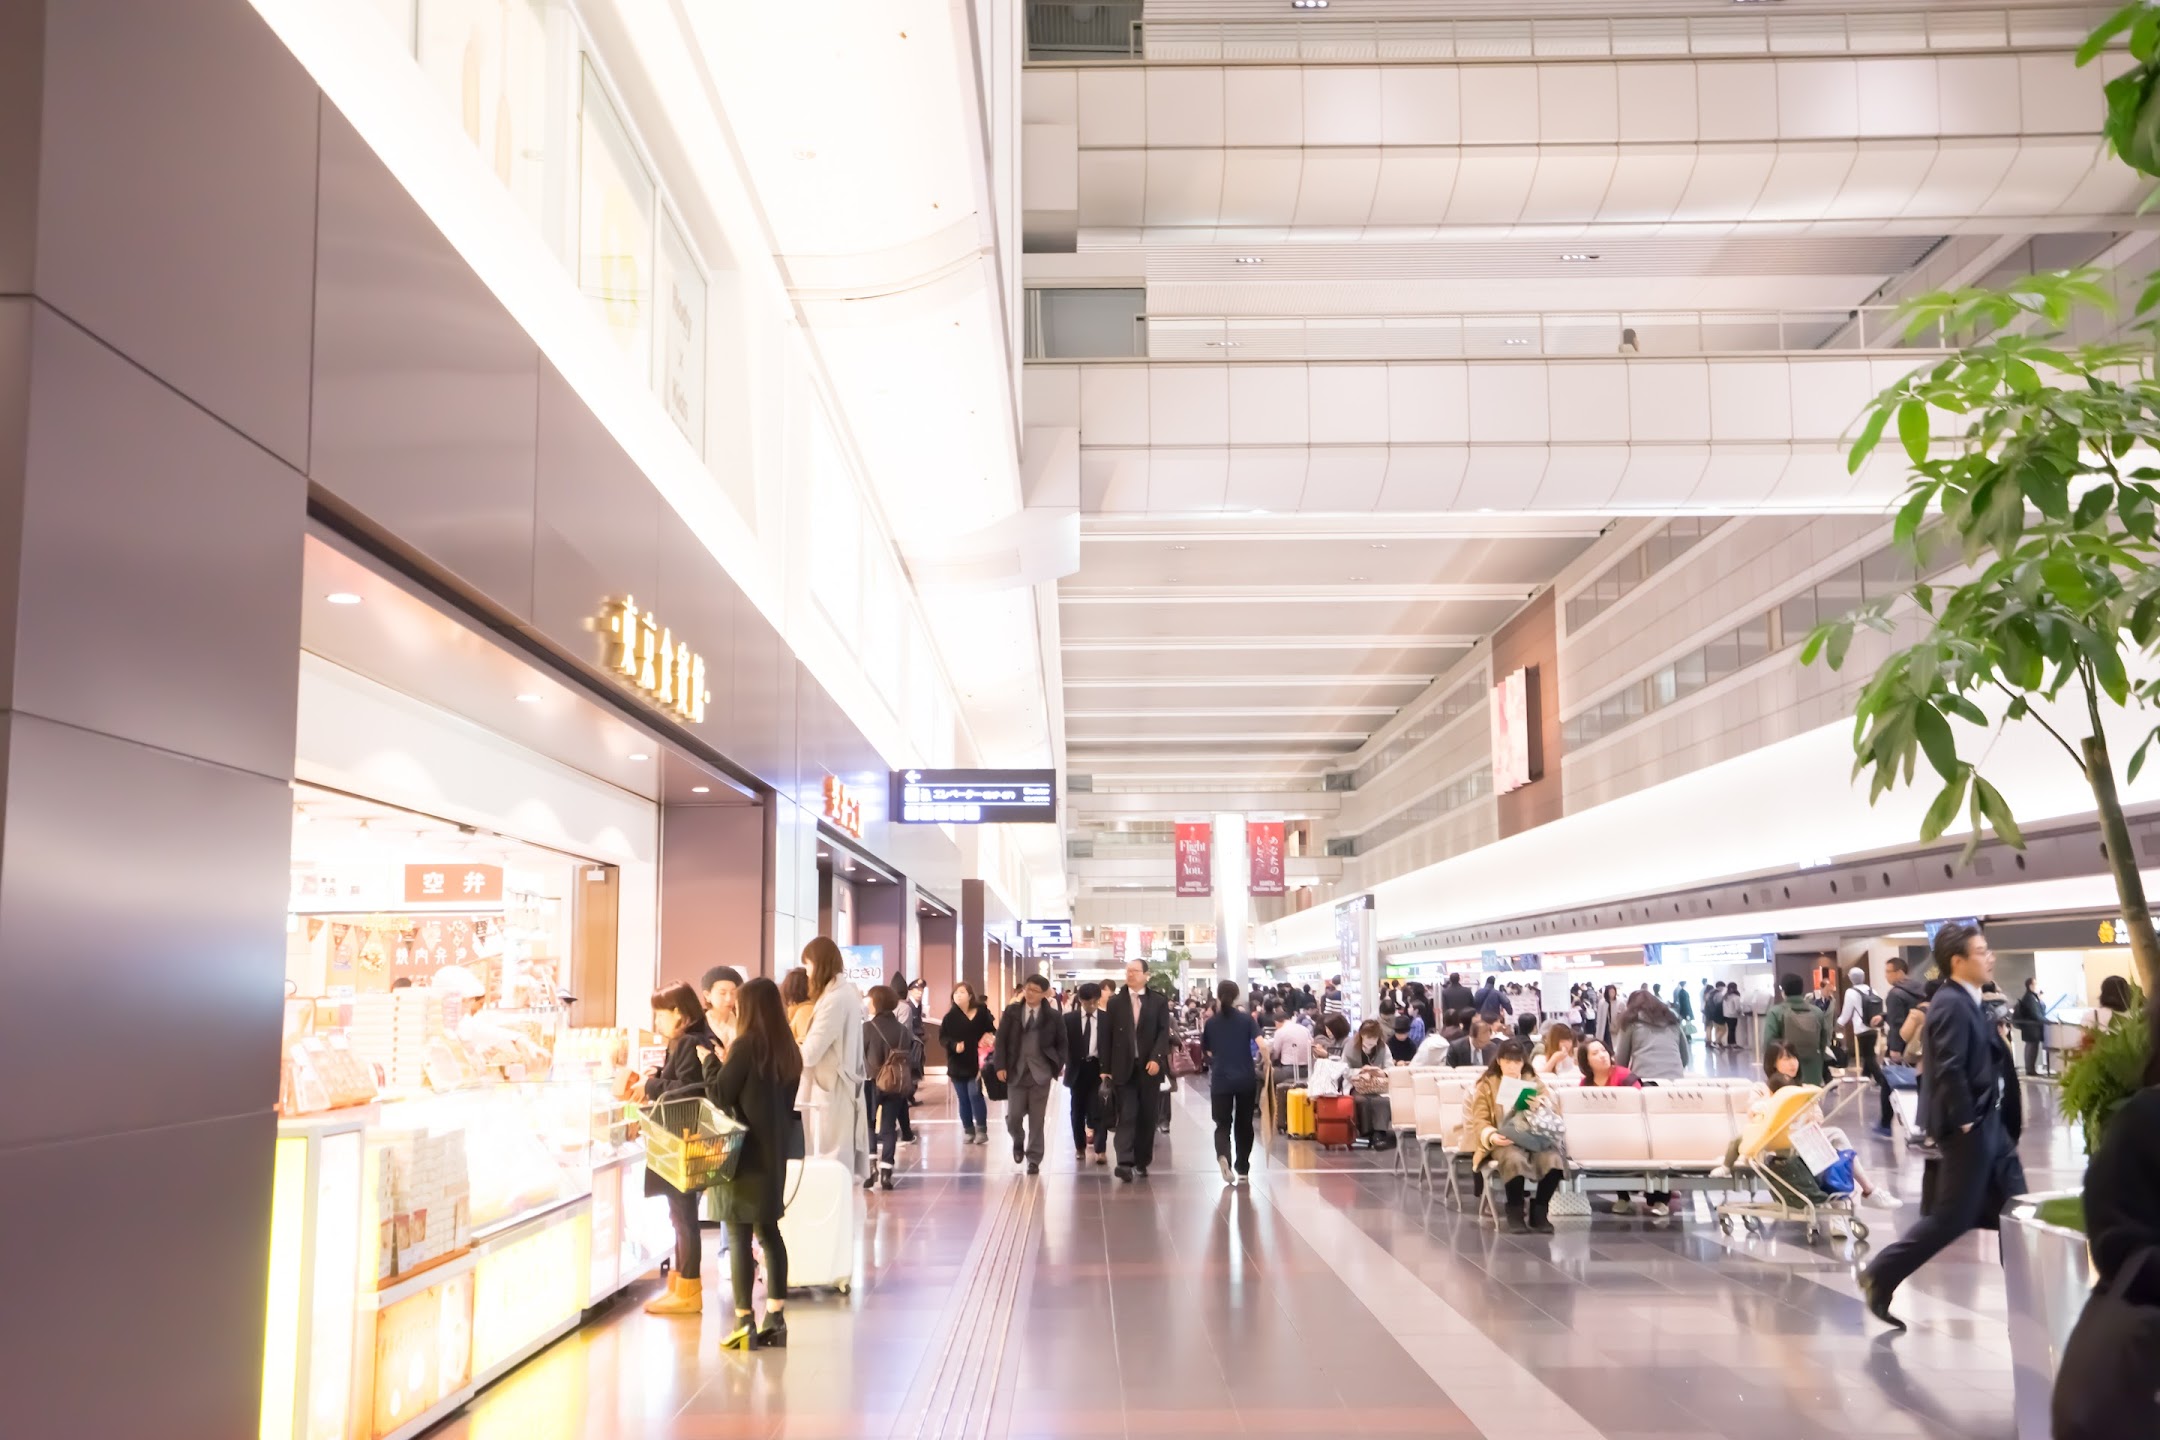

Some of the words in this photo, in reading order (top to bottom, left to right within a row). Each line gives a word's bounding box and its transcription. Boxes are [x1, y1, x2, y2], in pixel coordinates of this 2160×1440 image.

[1179, 839, 1206, 855] Flight
[1269, 836, 1279, 875] あなたの
[422, 871, 486, 894] 空弁
